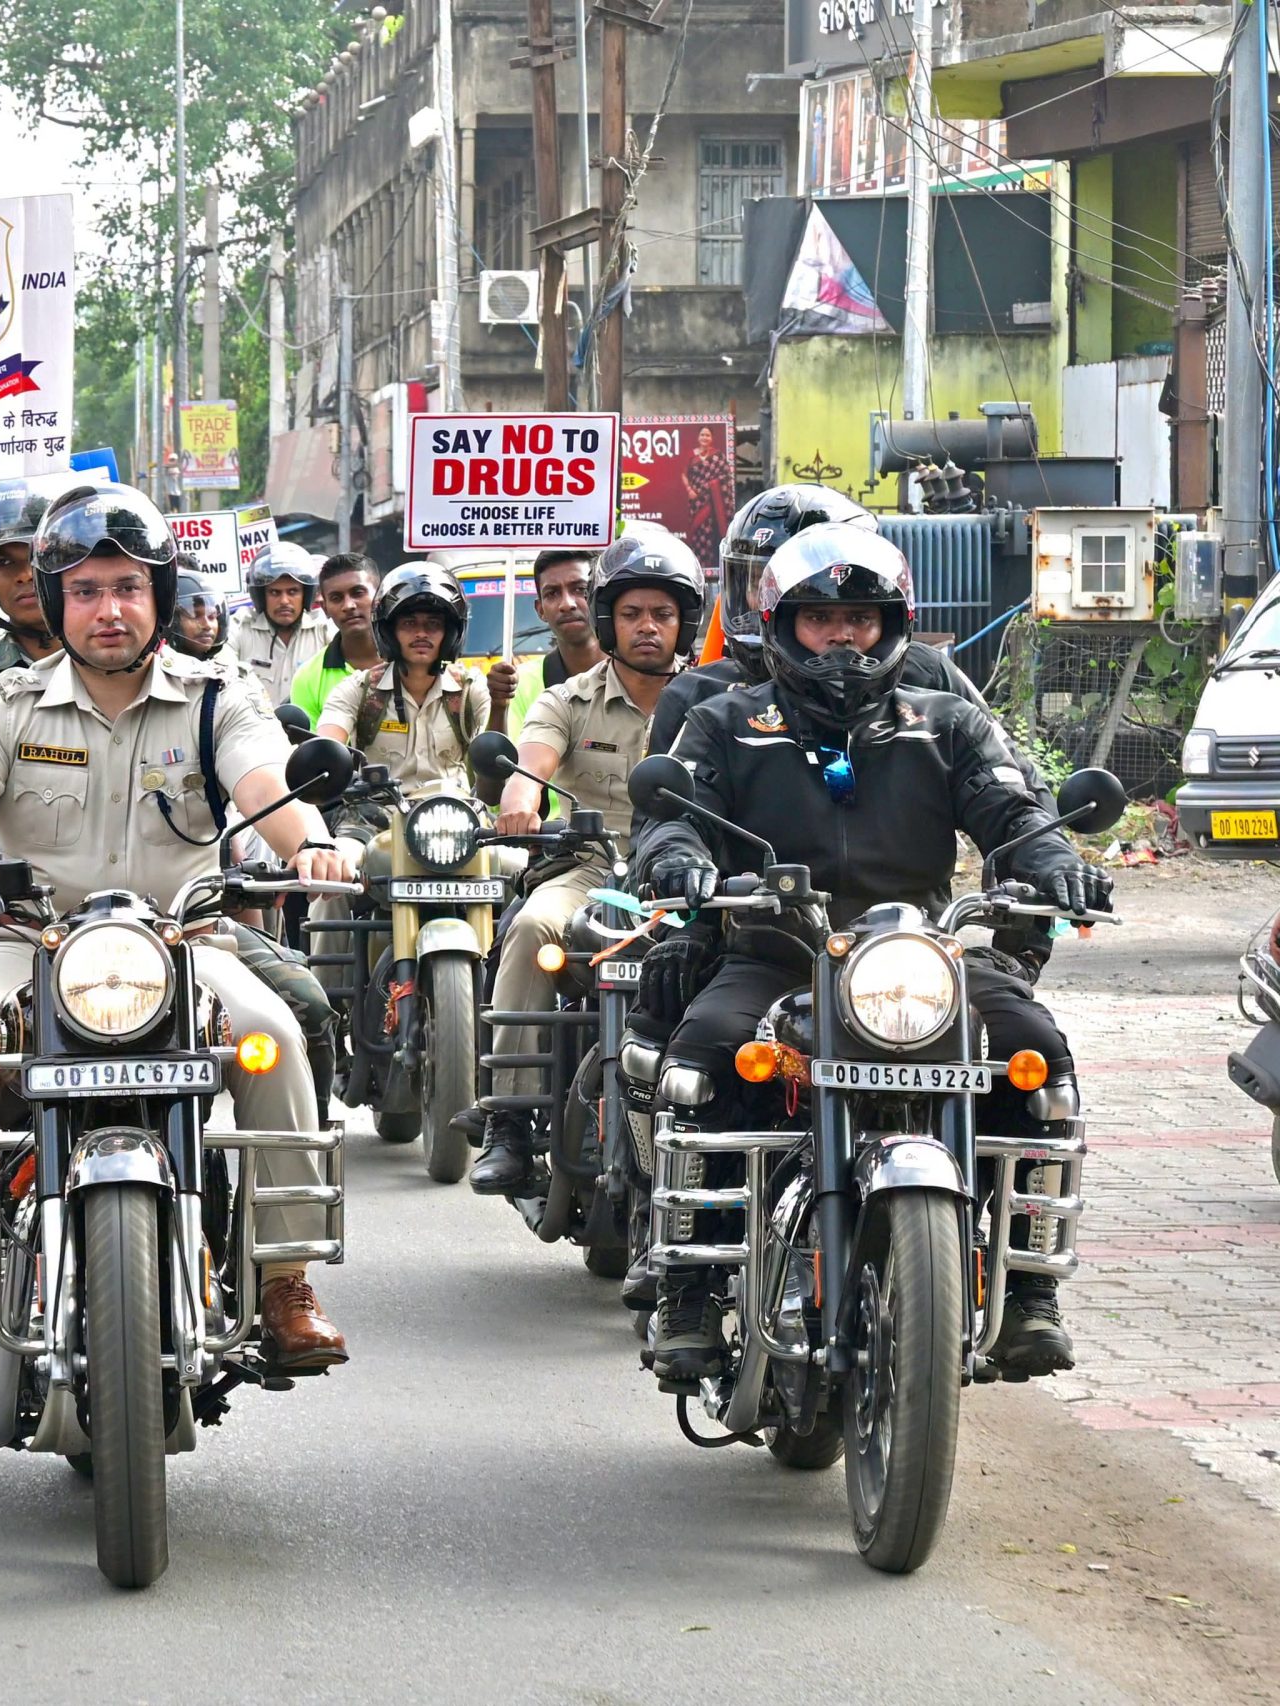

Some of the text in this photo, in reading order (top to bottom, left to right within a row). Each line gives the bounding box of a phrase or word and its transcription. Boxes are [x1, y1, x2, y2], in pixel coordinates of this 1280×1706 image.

[21, 271, 67, 290] INDIA
[3, 410, 15, 430] के
[21, 409, 58, 428] विरुद्ध
[187, 417, 232, 432] TRADE
[43, 435, 66, 457] युद्ध
[193, 432, 225, 446] FAIR
[432, 423, 599, 455] SAY NO TO
[432, 457, 596, 497] DRUGS
[460, 506, 556, 522] CHOOSE LIFE
[172, 519, 213, 538] UGS
[421, 522, 600, 538] CHOOSE A BETTER FUTURE
[178, 539, 210, 551] TROY
[201, 563, 227, 574] AND
[28, 747, 82, 762] RAHUL
[1252, 819, 1274, 836] 2294
[632, 1090, 651, 1100] PRO
